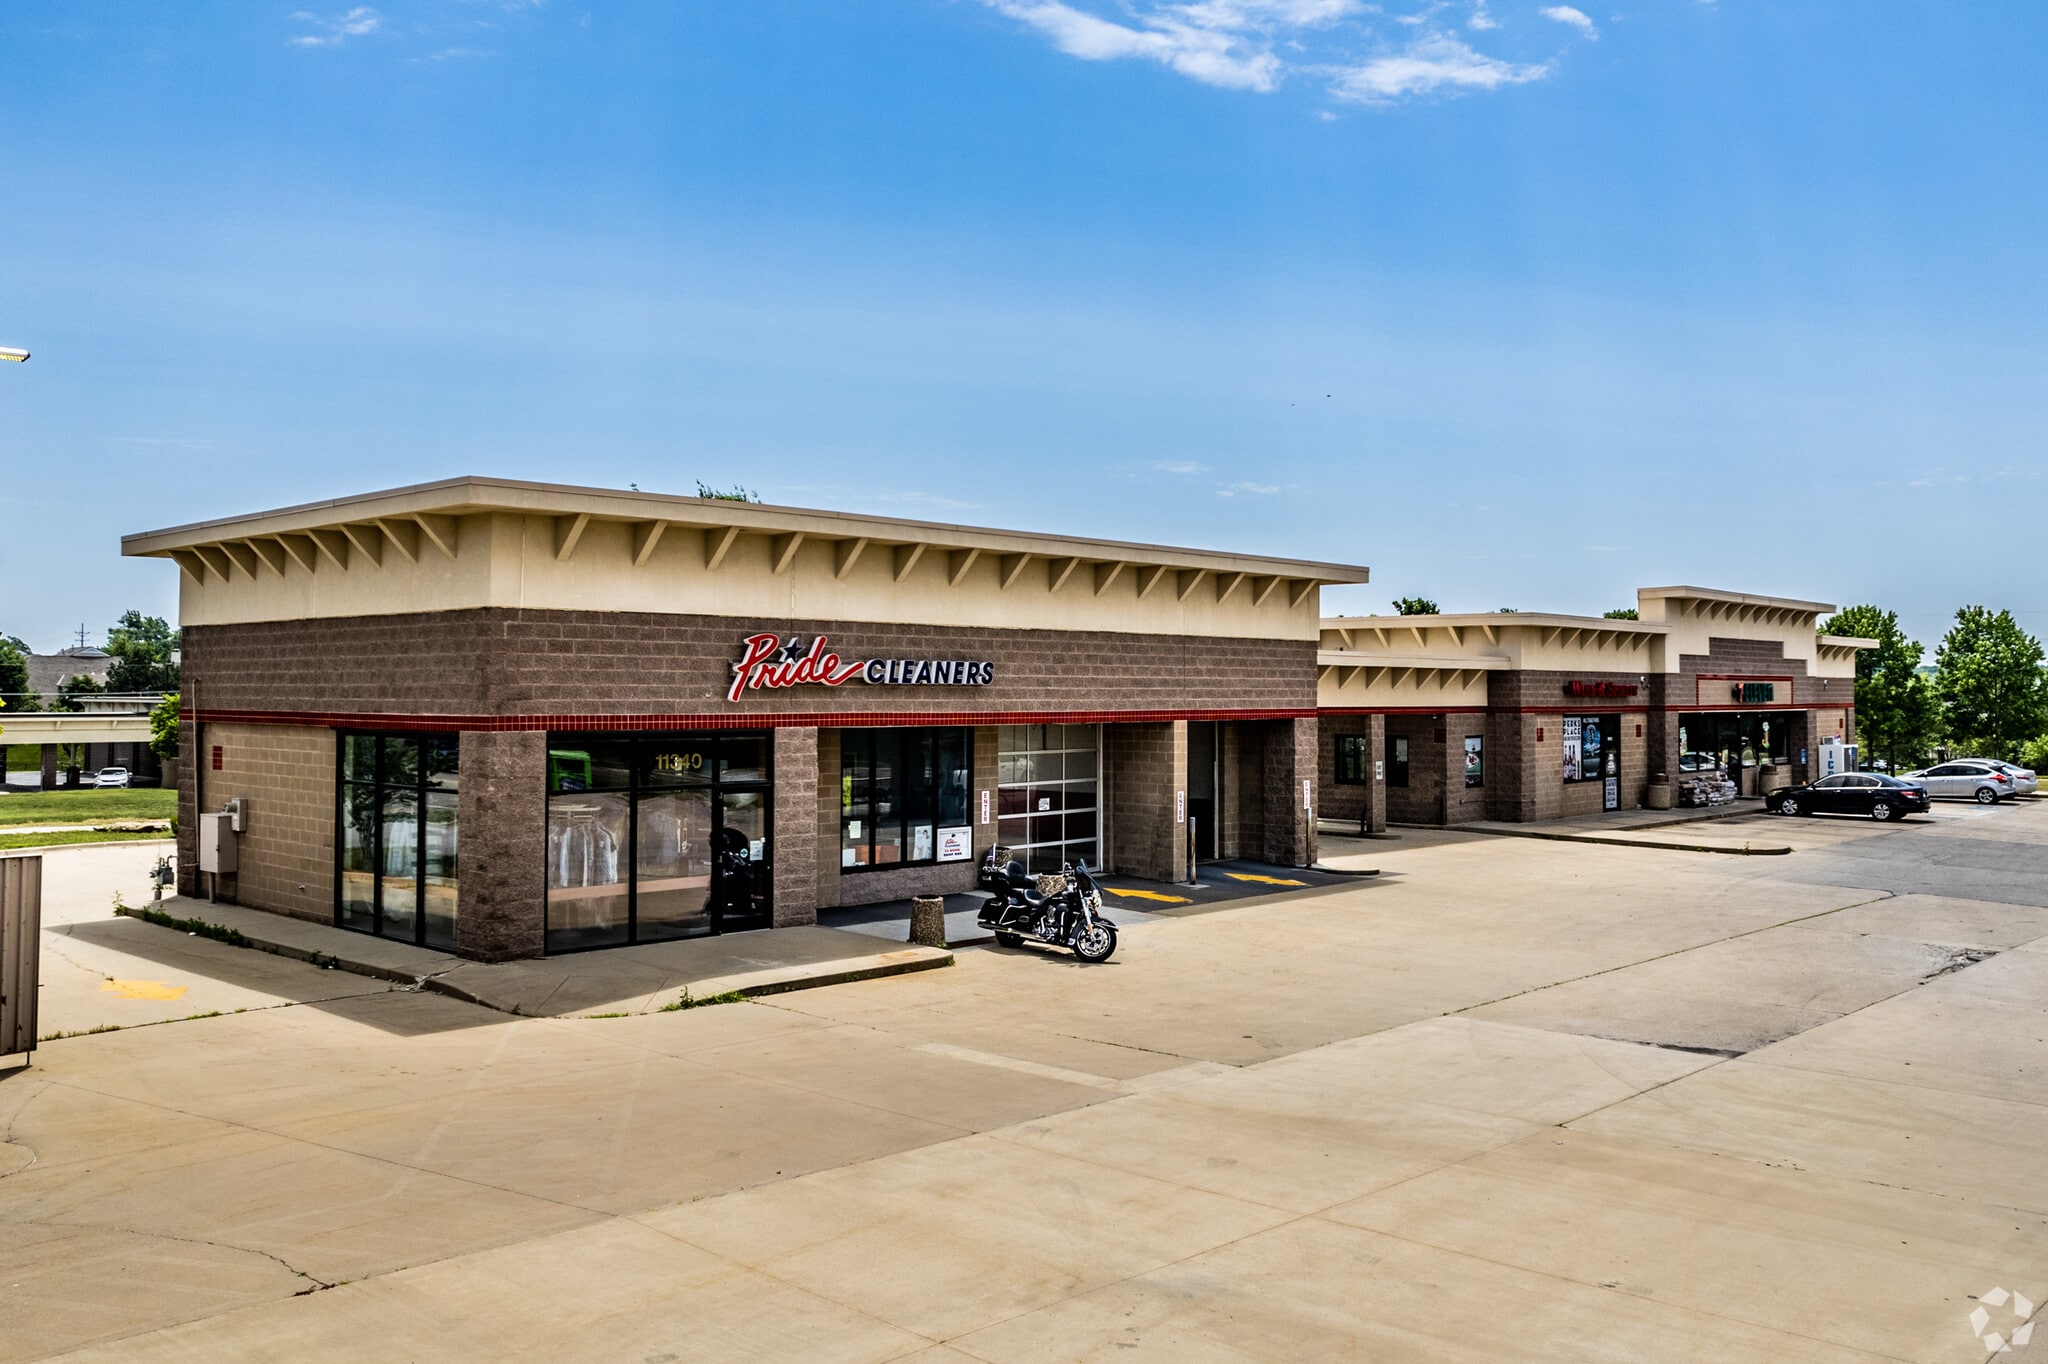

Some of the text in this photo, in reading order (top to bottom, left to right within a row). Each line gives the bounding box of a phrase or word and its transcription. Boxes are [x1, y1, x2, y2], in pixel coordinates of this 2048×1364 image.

[728, 633, 994, 702] Pride CLEANERS
[655, 753, 702, 770] 11340
